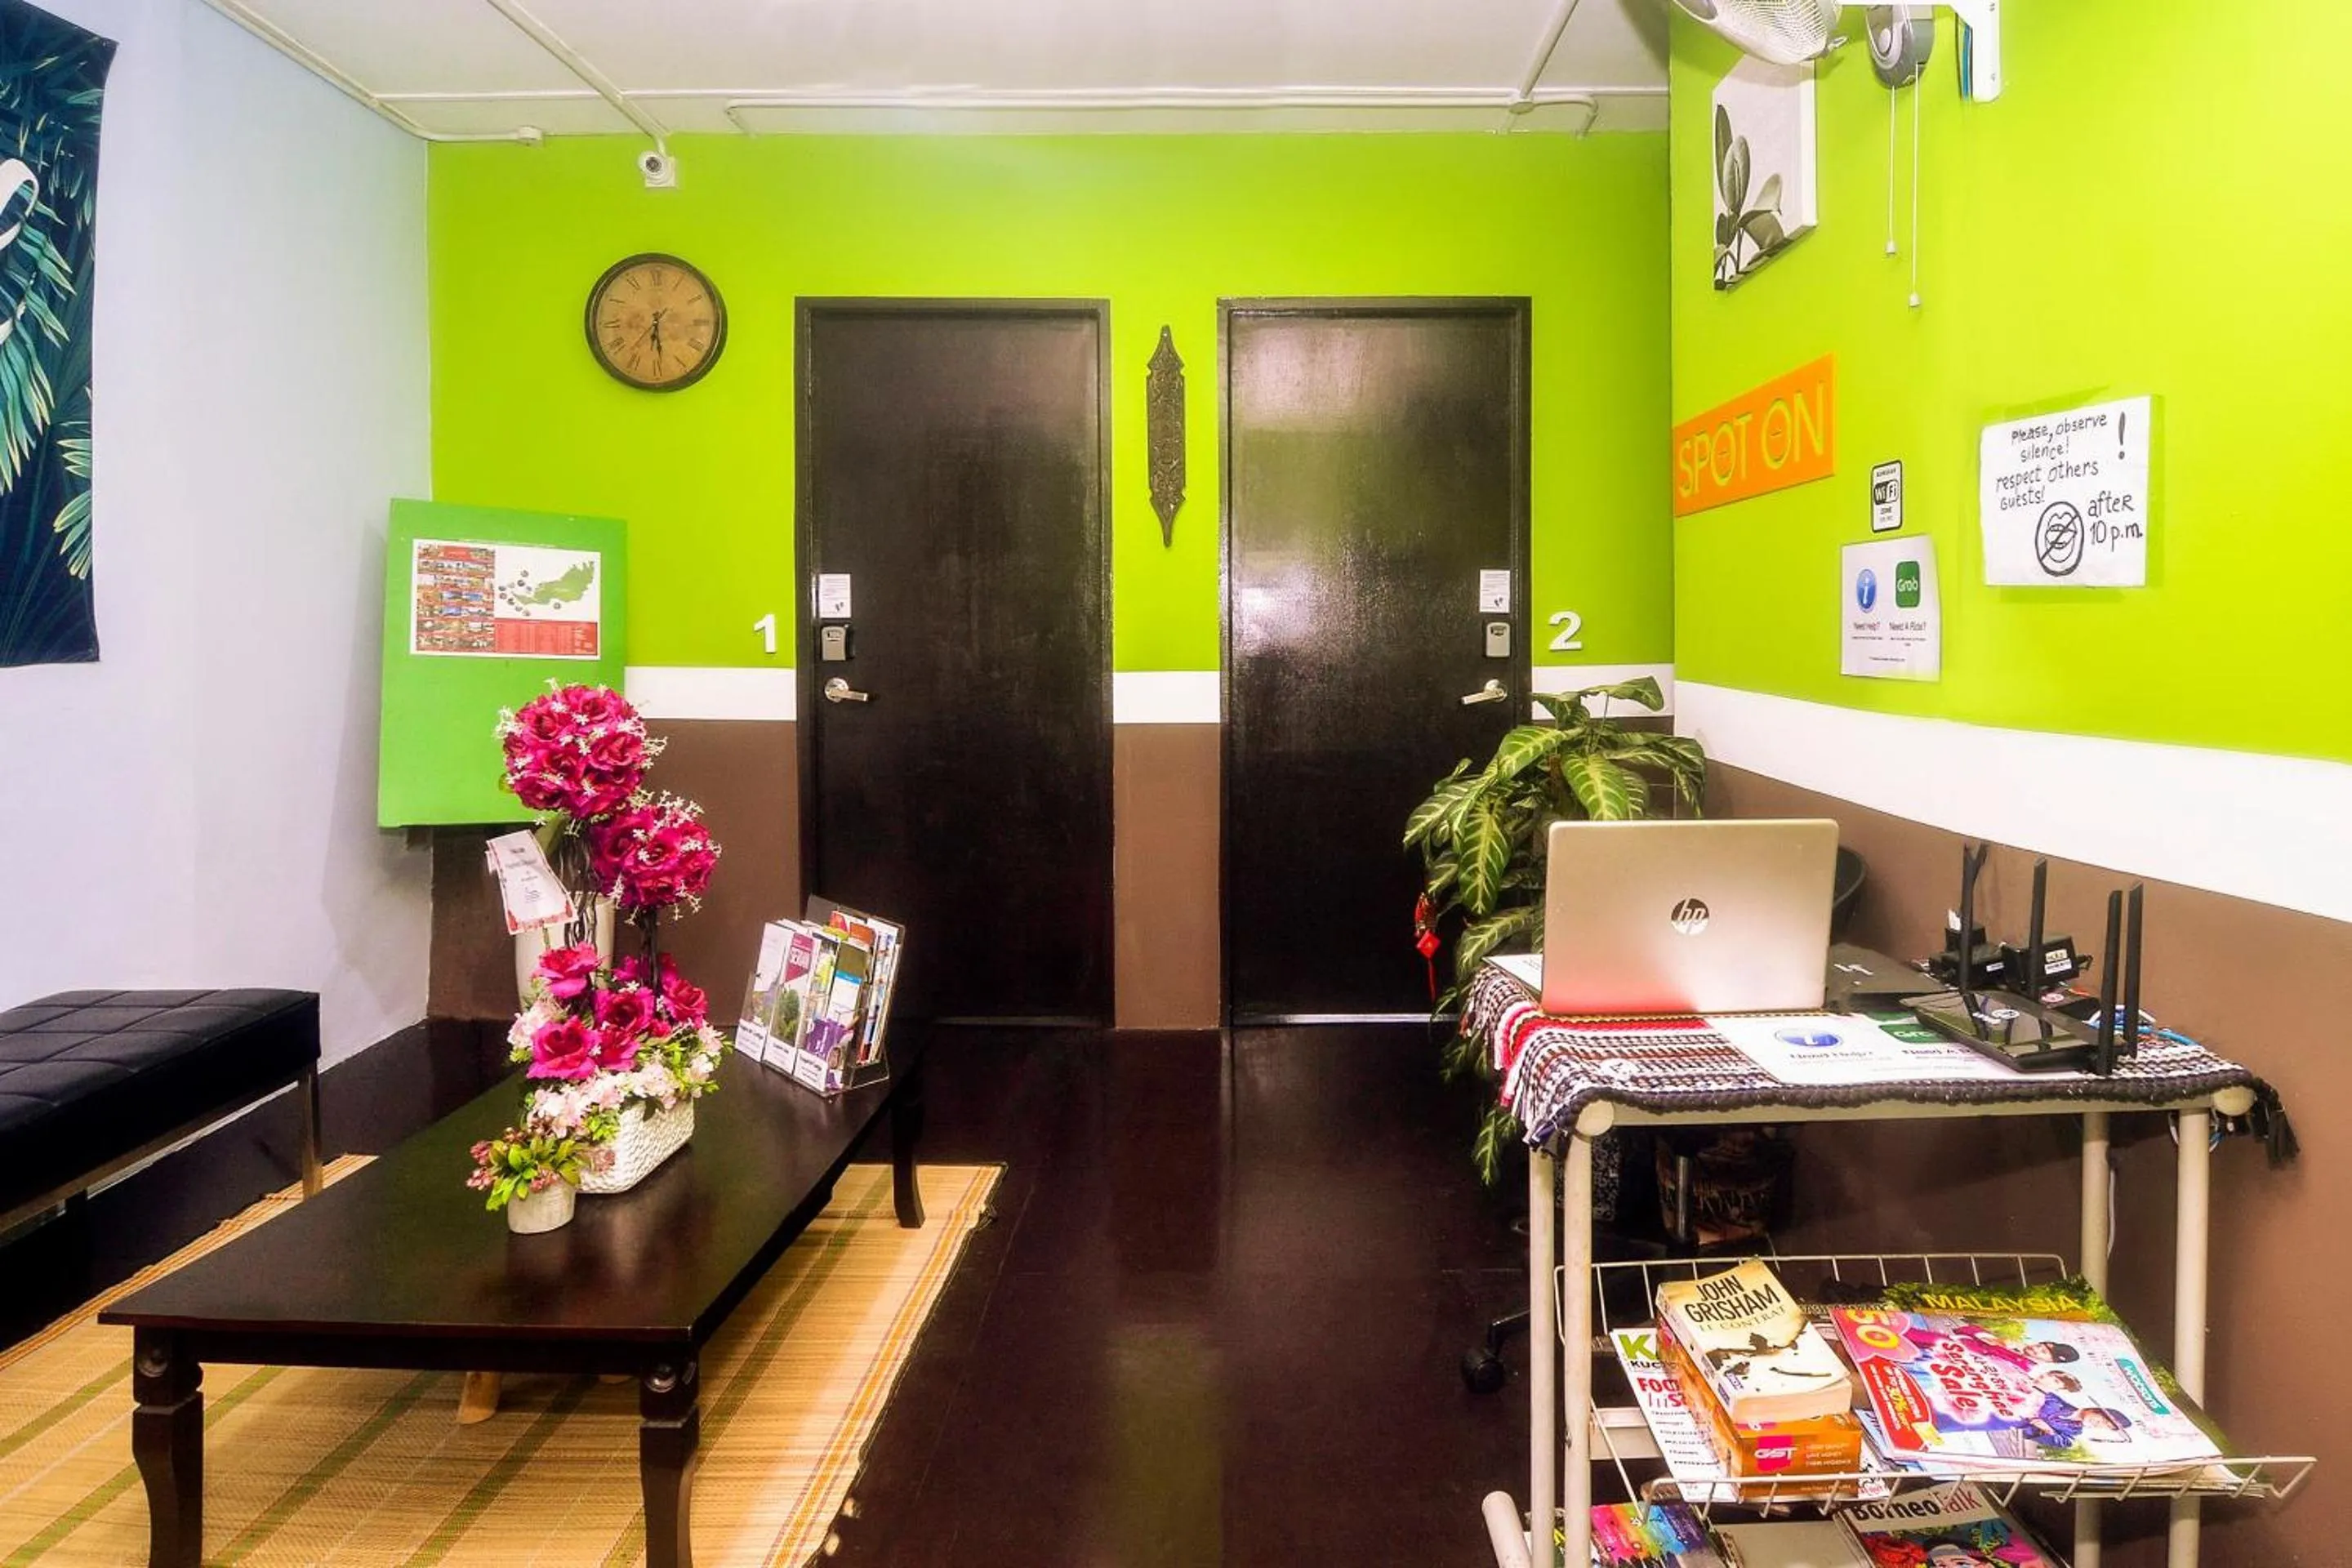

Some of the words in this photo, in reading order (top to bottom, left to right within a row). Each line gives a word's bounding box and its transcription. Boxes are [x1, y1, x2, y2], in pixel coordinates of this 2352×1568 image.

[2055, 412, 2108, 435] observe
[1678, 411, 1753, 498] SPOT
[1761, 381, 1825, 470] ON
[2020, 435, 2070, 463] silence!
[1995, 466, 2042, 494] respect
[2047, 460, 2100, 483] others
[2089, 520, 2107, 546] 10
[1897, 577, 1919, 592] Grab
[753, 612, 776, 654] 1
[1548, 610, 1583, 652] 2
[1673, 898, 1708, 934] hp
[1684, 1283, 1781, 1323] GRISHAM
[1695, 1274, 1745, 1302] JOHN
[1921, 1293, 2082, 1313] MALAYSIA
[1719, 1305, 1787, 1330] CONTRAT
[1930, 1363, 1984, 1412] Sale
